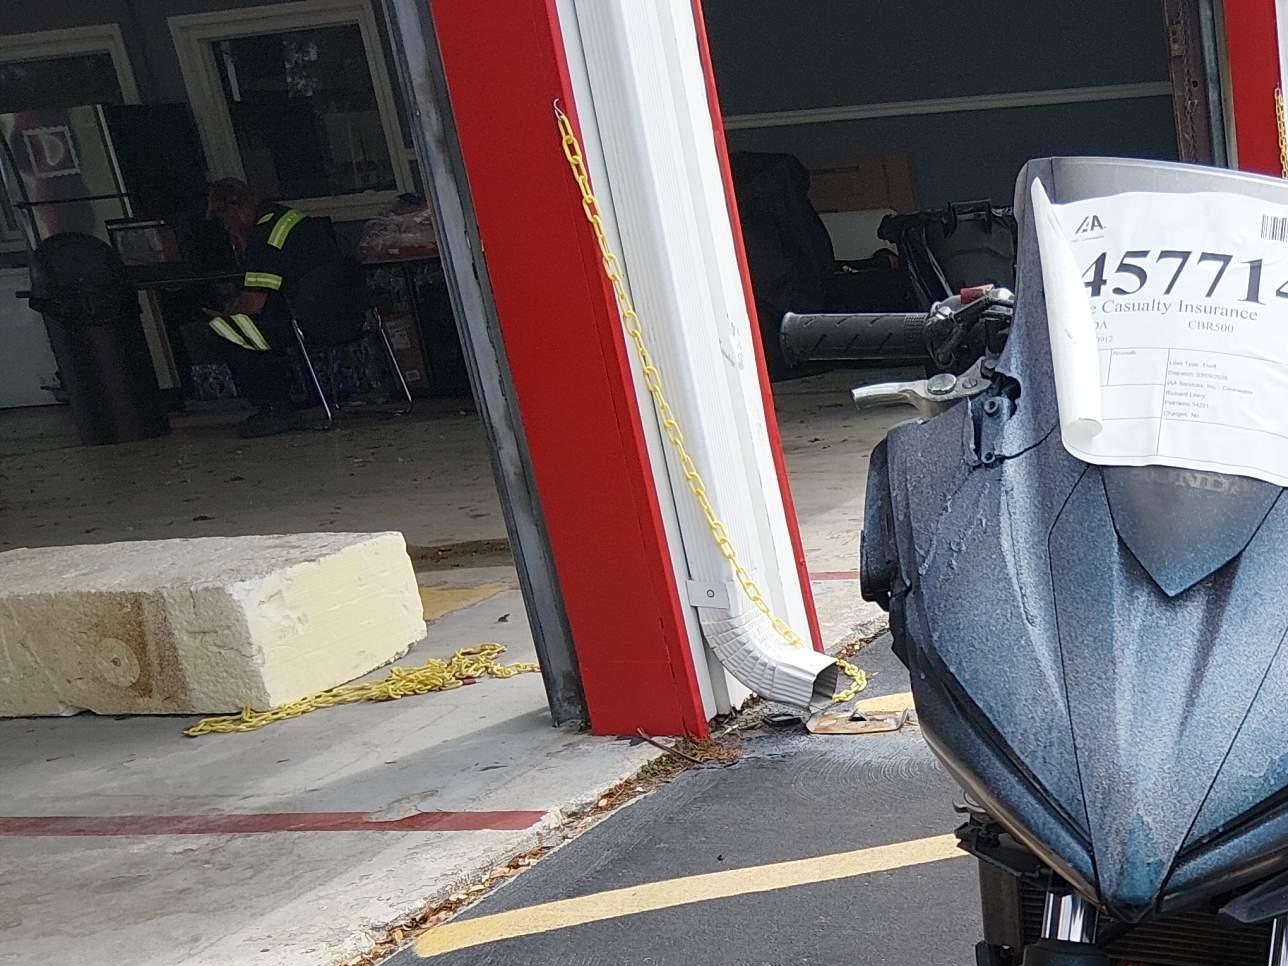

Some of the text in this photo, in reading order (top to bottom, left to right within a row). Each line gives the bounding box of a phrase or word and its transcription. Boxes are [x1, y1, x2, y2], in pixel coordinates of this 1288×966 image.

[1101, 297, 1172, 315] Casualty
[1178, 298, 1259, 322] Insurance
[1188, 319, 1235, 334] CBR500
